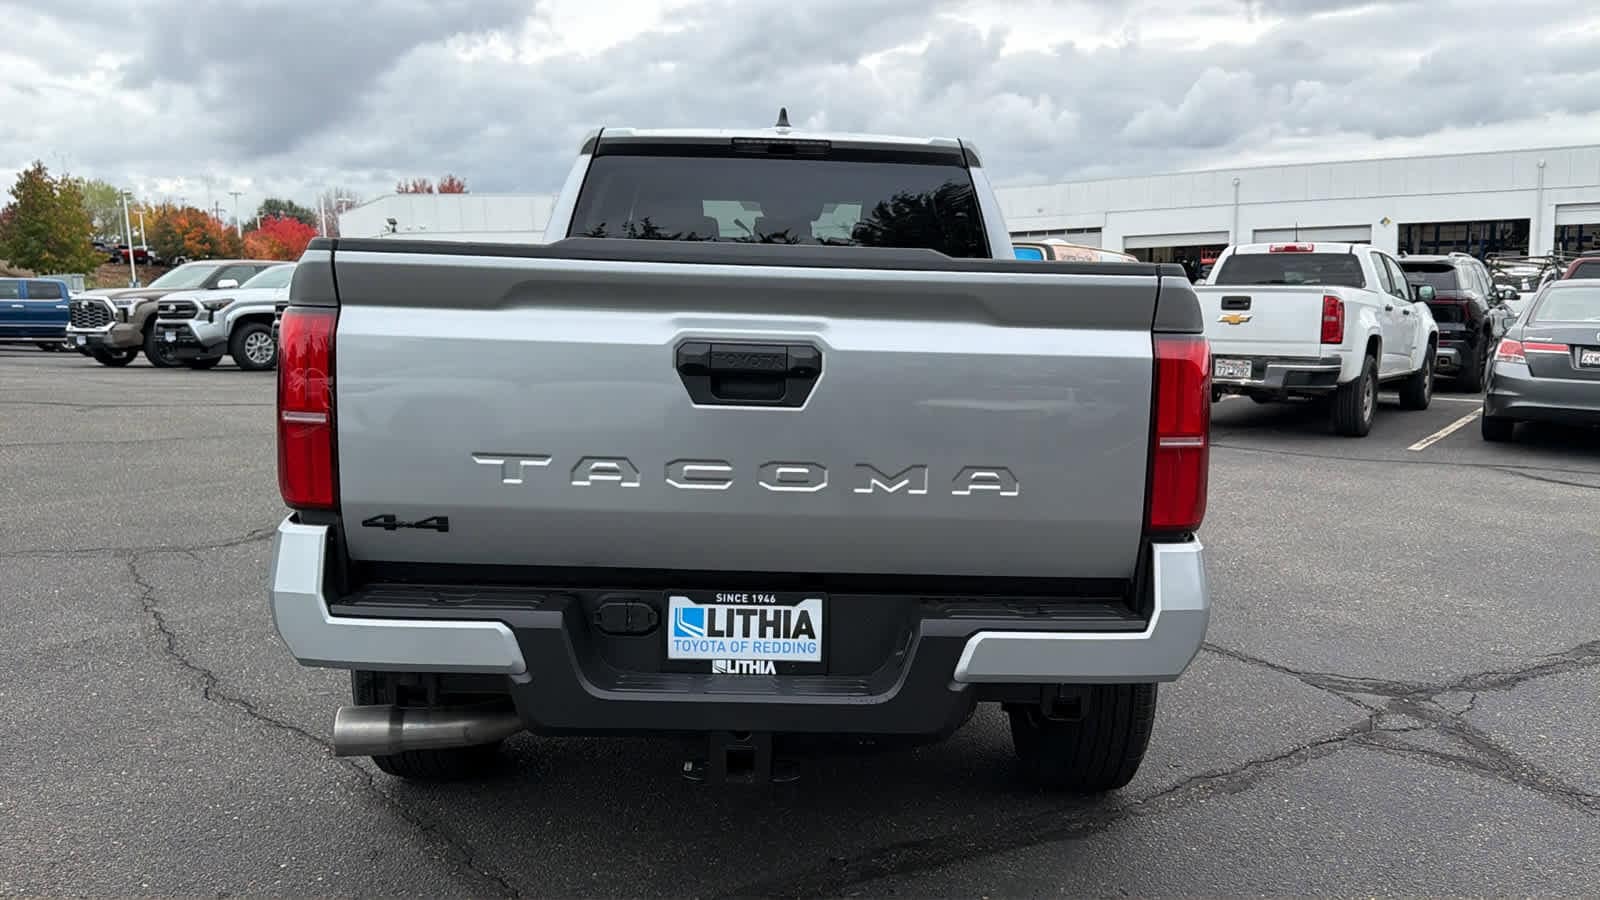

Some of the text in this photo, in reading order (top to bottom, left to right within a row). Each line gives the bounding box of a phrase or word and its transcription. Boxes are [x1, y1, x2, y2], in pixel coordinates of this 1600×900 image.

[711, 352, 785, 368] TOYOTA
[472, 452, 1019, 496] TACOMA
[716, 593, 776, 604] SINCE 1946
[707, 608, 816, 639] LITHIA
[673, 640, 817, 654] TOYOTA OF REDDING
[727, 660, 776, 674] LITHIA
